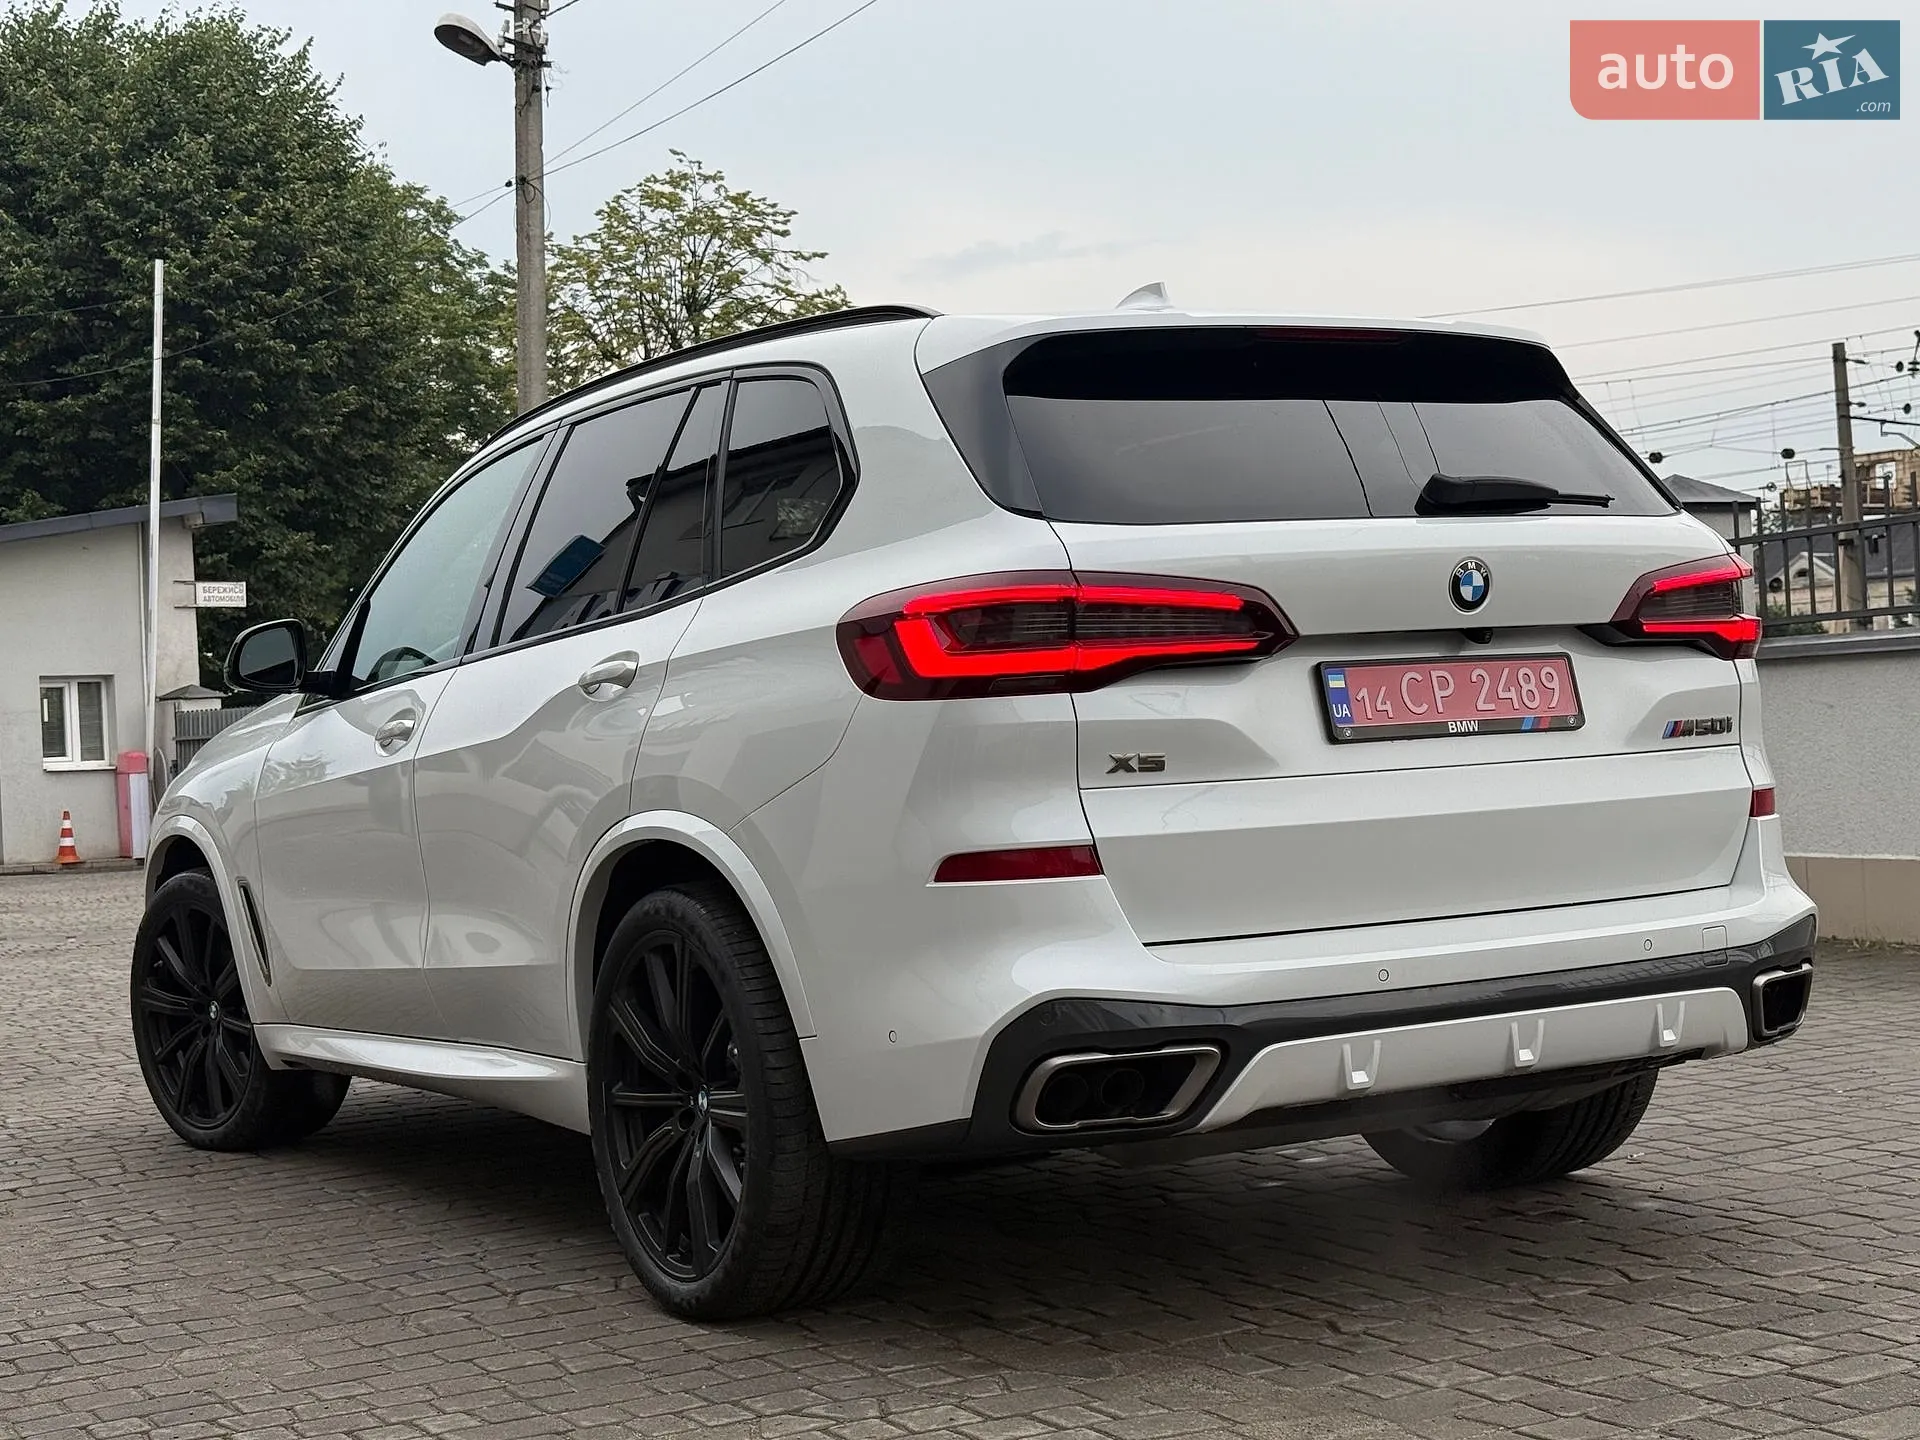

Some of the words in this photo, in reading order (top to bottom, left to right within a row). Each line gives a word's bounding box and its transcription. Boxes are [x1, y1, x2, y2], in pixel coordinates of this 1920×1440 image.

[1456, 561, 1488, 577] BMW
[202, 585, 244, 594] БЕРЕЖИСЬ
[1355, 685, 1394, 720] 14
[1400, 669, 1455, 716] CP
[1470, 666, 1560, 712] 2489
[1333, 703, 1351, 718] UA
[1448, 720, 1479, 734] BMW
[1105, 752, 1166, 774] X5
